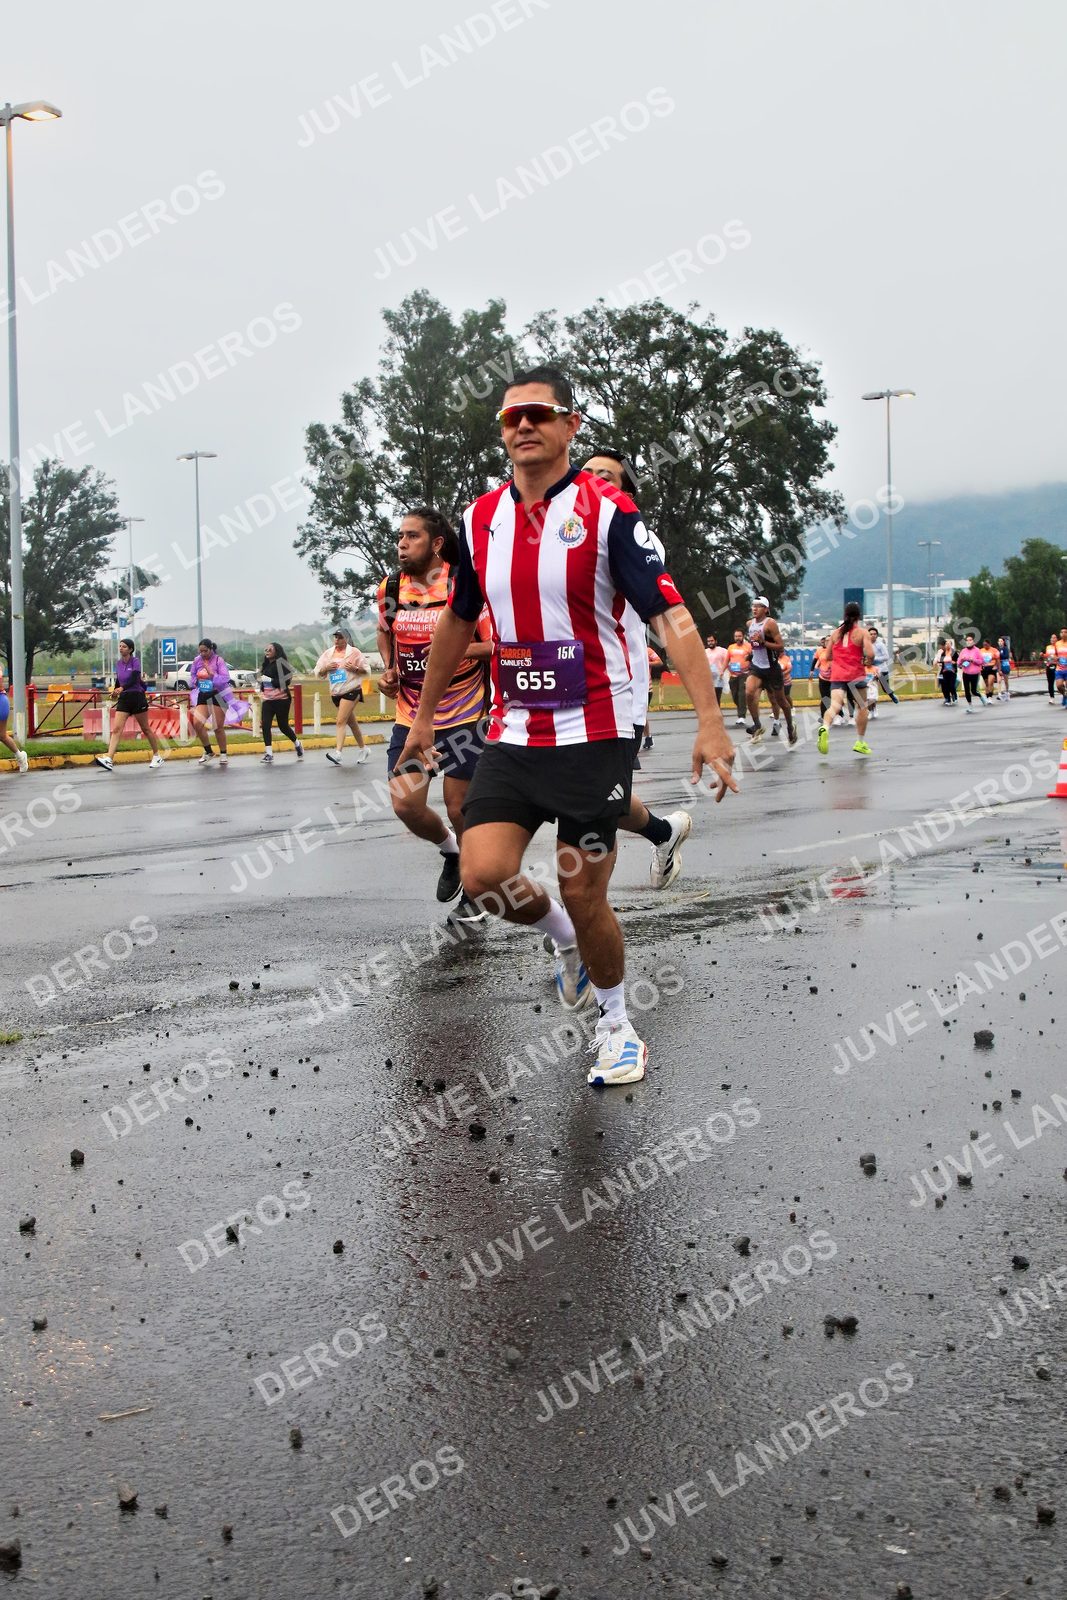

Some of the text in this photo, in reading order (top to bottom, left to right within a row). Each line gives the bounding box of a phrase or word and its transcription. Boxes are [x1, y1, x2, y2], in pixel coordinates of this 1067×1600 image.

[397, 609, 442, 623] CARRER
[396, 623, 433, 632] OMNILIFE
[500, 648, 532, 659] CARRERA
[557, 646, 575, 660] 15K
[516, 671, 556, 690] 655
